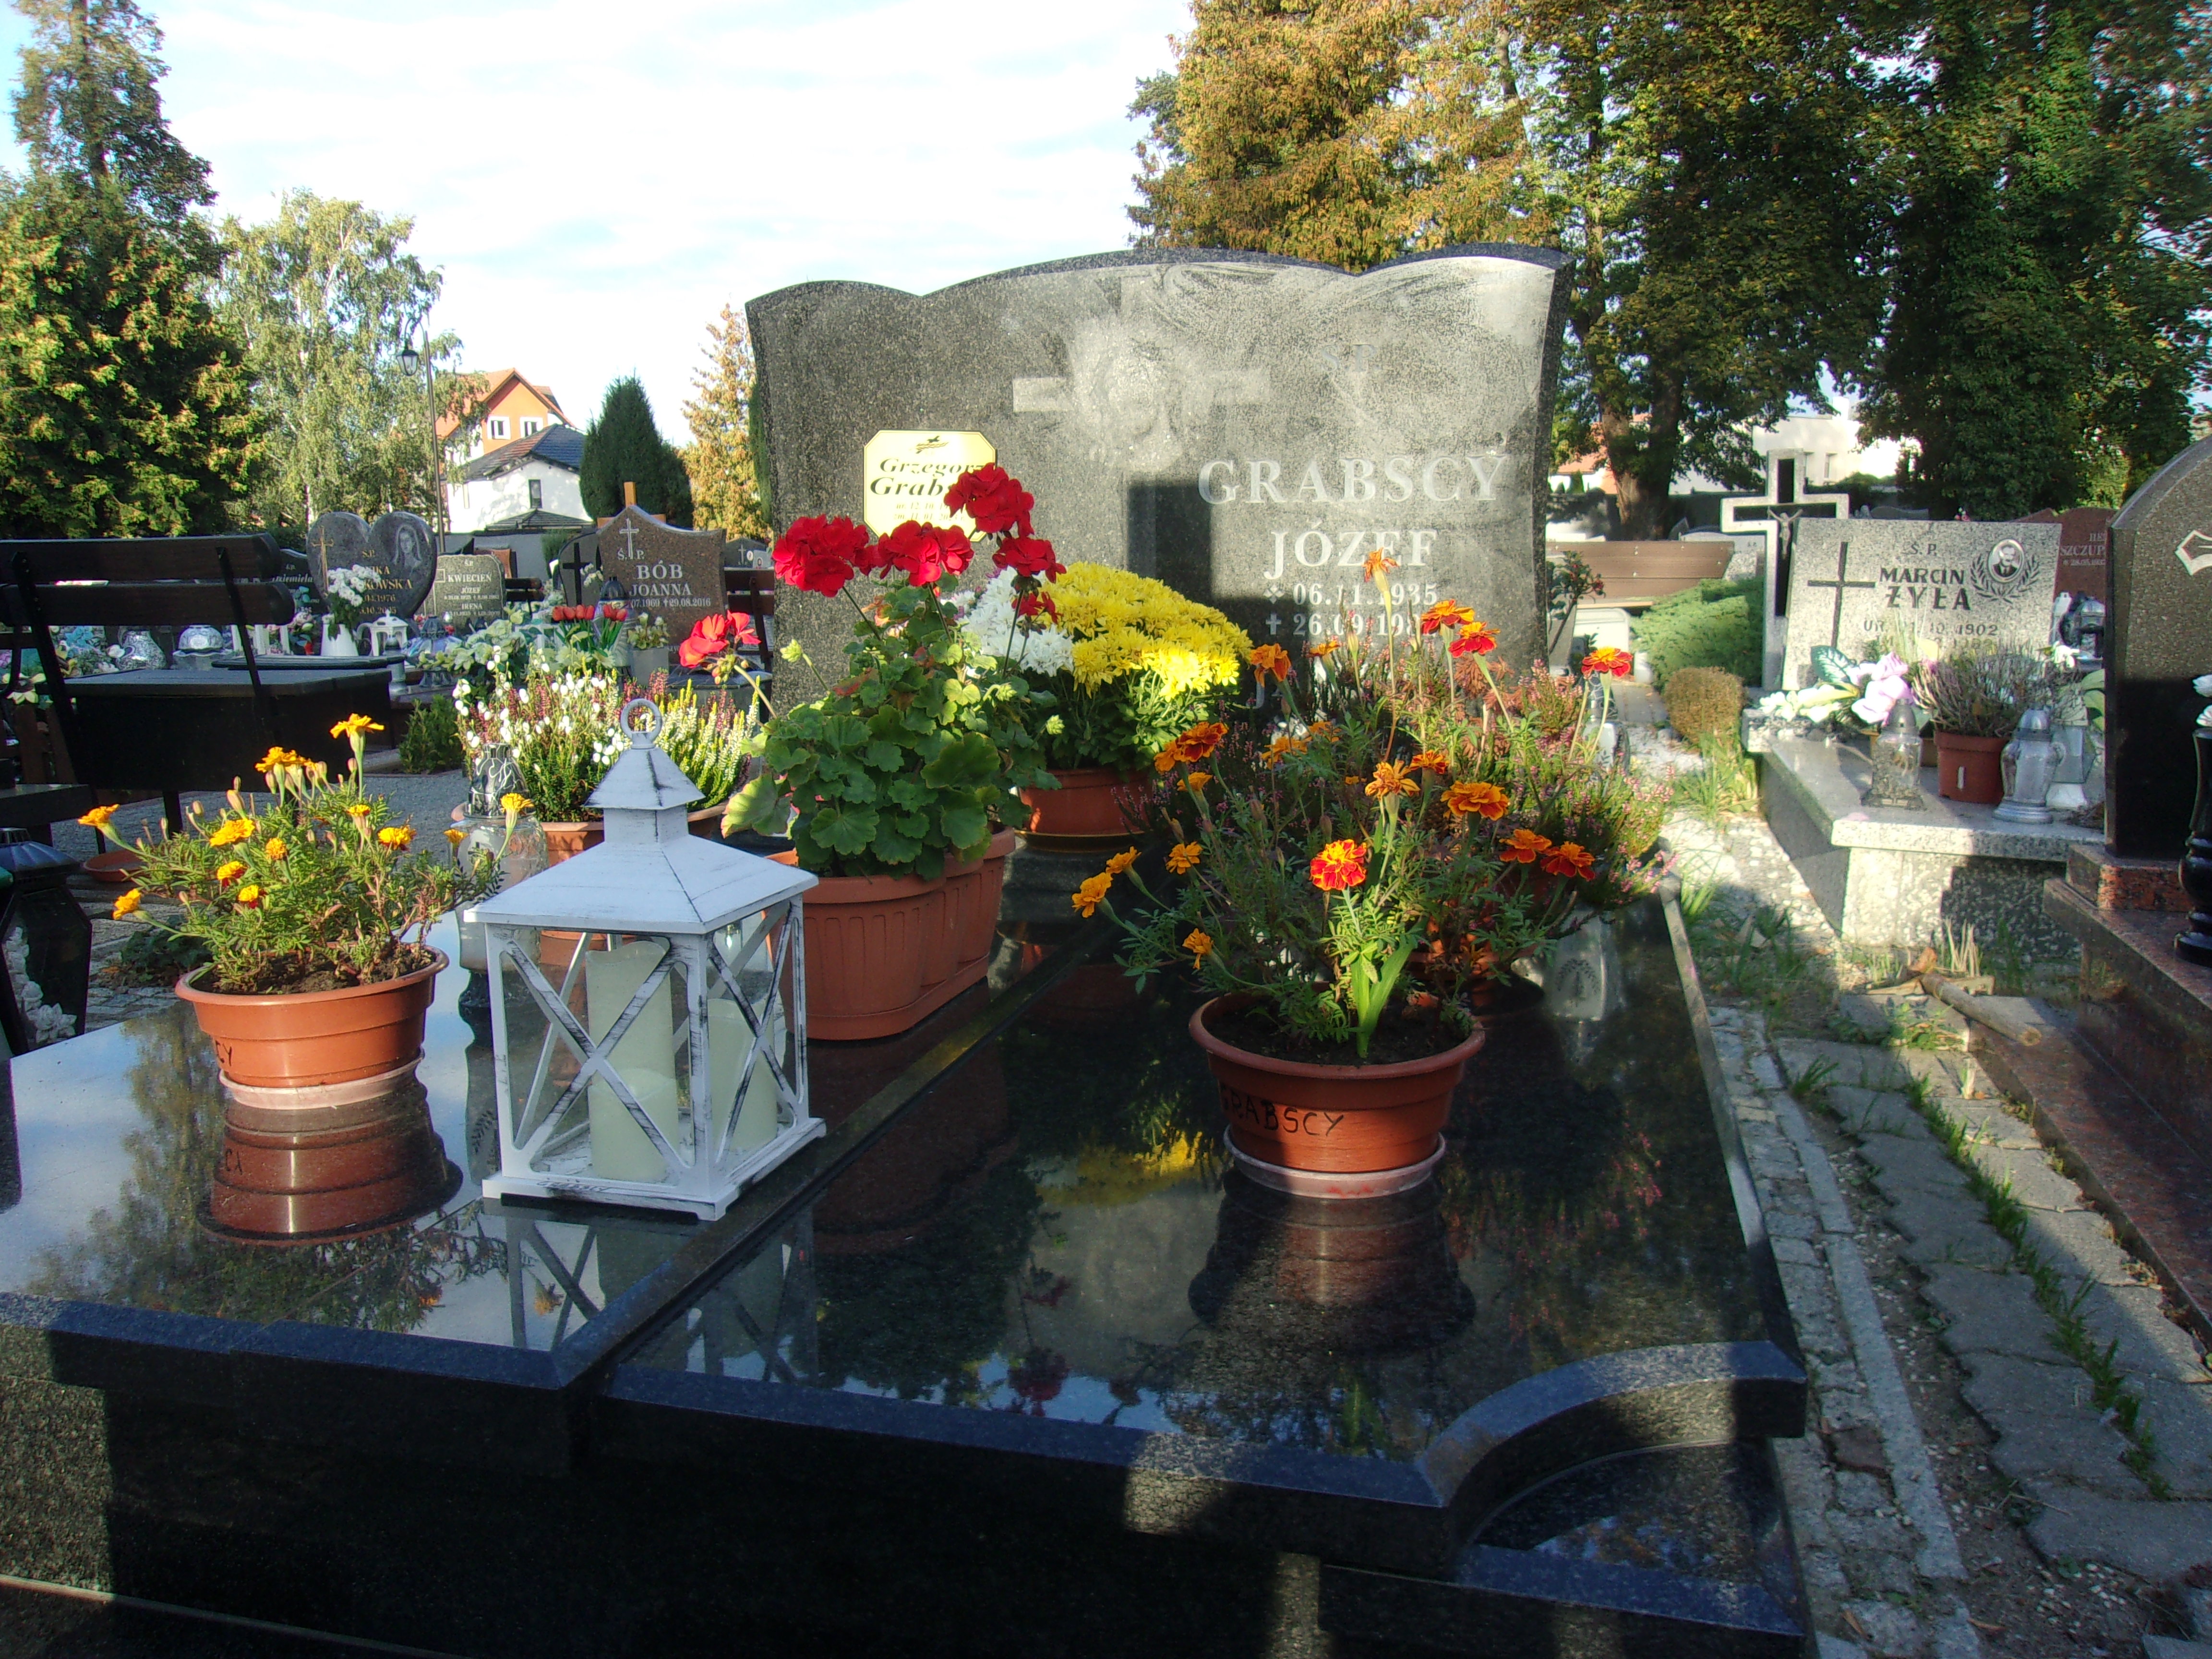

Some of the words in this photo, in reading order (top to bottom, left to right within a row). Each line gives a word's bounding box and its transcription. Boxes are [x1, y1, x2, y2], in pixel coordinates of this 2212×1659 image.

[1198, 455, 1507, 505] GRABSCY
[1263, 520, 1439, 580] JÓZEF
[636, 560, 683, 579] BÓB
[1879, 567, 1965, 584] MARCIN
[629, 583, 693, 596] JOANNA
[1885, 585, 1971, 611] ŻYŁA
